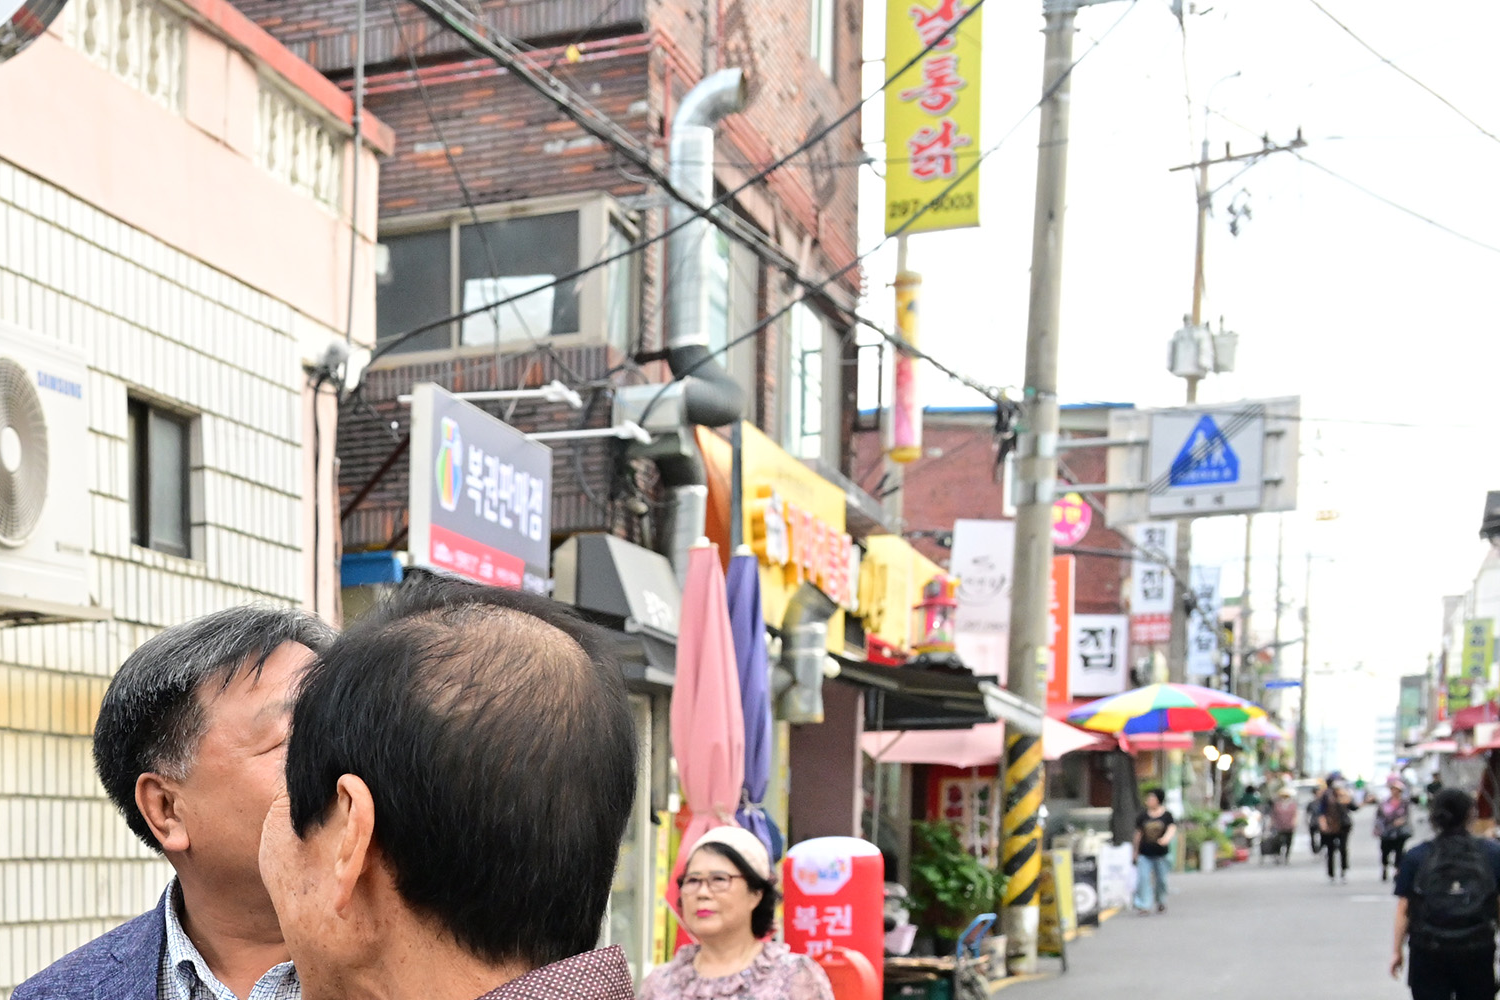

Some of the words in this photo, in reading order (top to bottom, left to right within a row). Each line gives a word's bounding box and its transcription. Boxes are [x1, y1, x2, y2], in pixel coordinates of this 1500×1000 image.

[37, 370, 82, 400] SAMSUNG
[465, 443, 544, 542] 복권판매점
[1078, 625, 1120, 673] 집
[793, 904, 853, 937] 복권
